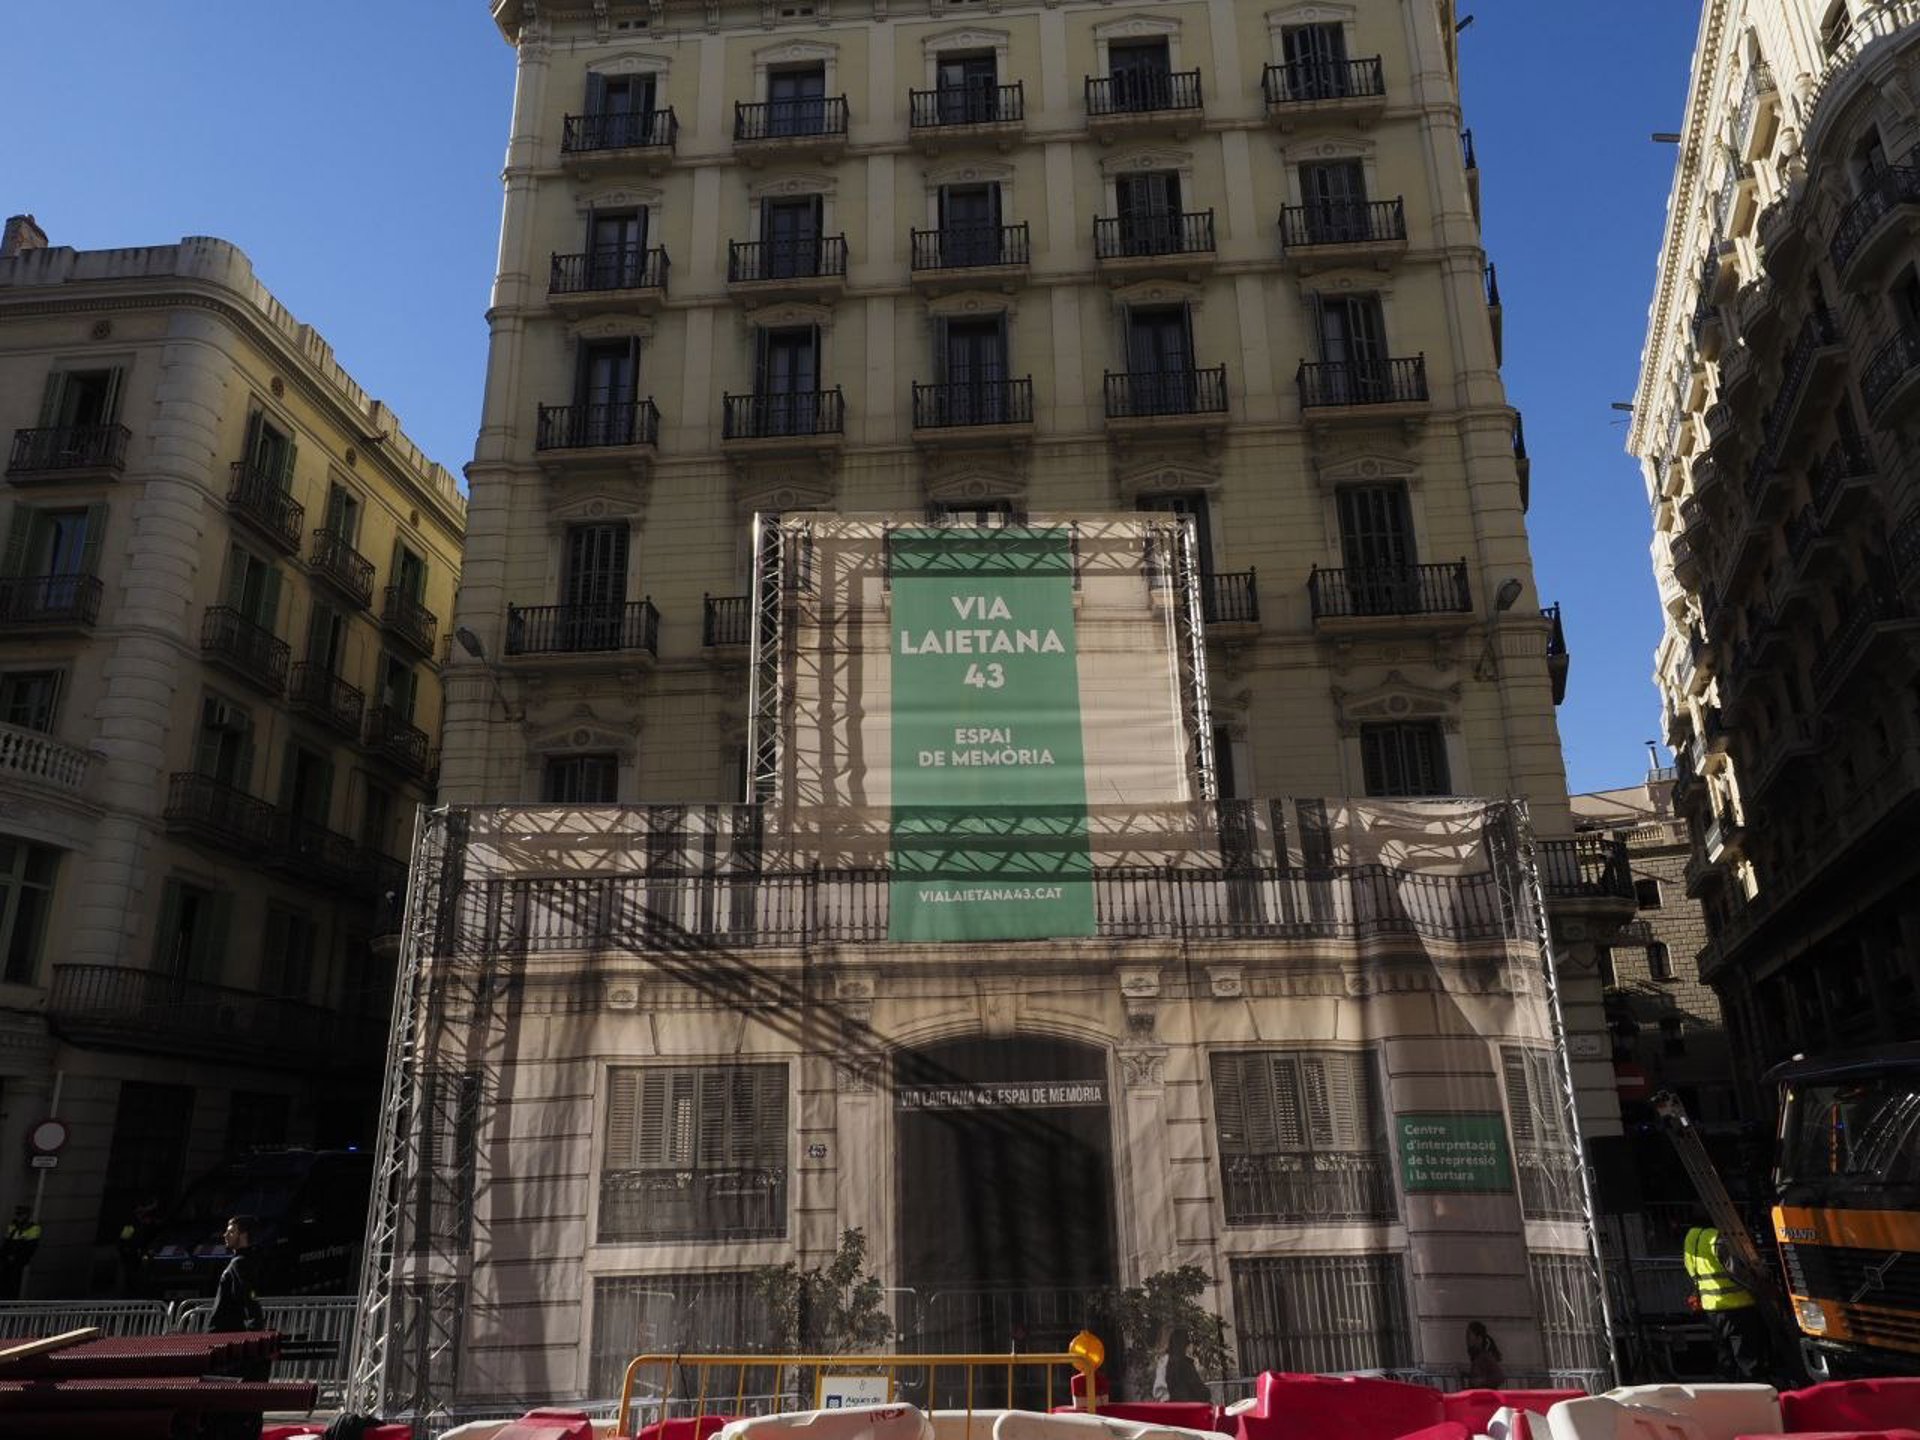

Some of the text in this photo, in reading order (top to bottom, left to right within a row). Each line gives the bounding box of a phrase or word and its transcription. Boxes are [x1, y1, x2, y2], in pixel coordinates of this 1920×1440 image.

[951, 596, 1012, 620] VIA
[901, 629, 1065, 654] LAIETANA
[964, 663, 1005, 688] 43
[955, 728, 1011, 745] ESPAI
[919, 746, 1055, 767] DE MEMÒRIA
[919, 887, 1062, 902] VIALAIETANA43.CAT
[998, 1088, 1029, 1104] ESPAI
[1033, 1088, 1047, 1103] DE
[1405, 1124, 1446, 1135] Centre
[1407, 1139, 1497, 1152] d'interpretació
[1408, 1154, 1496, 1168] de la repressió
[1416, 1170, 1427, 1180] la
[1431, 1171, 1474, 1180] tortura
